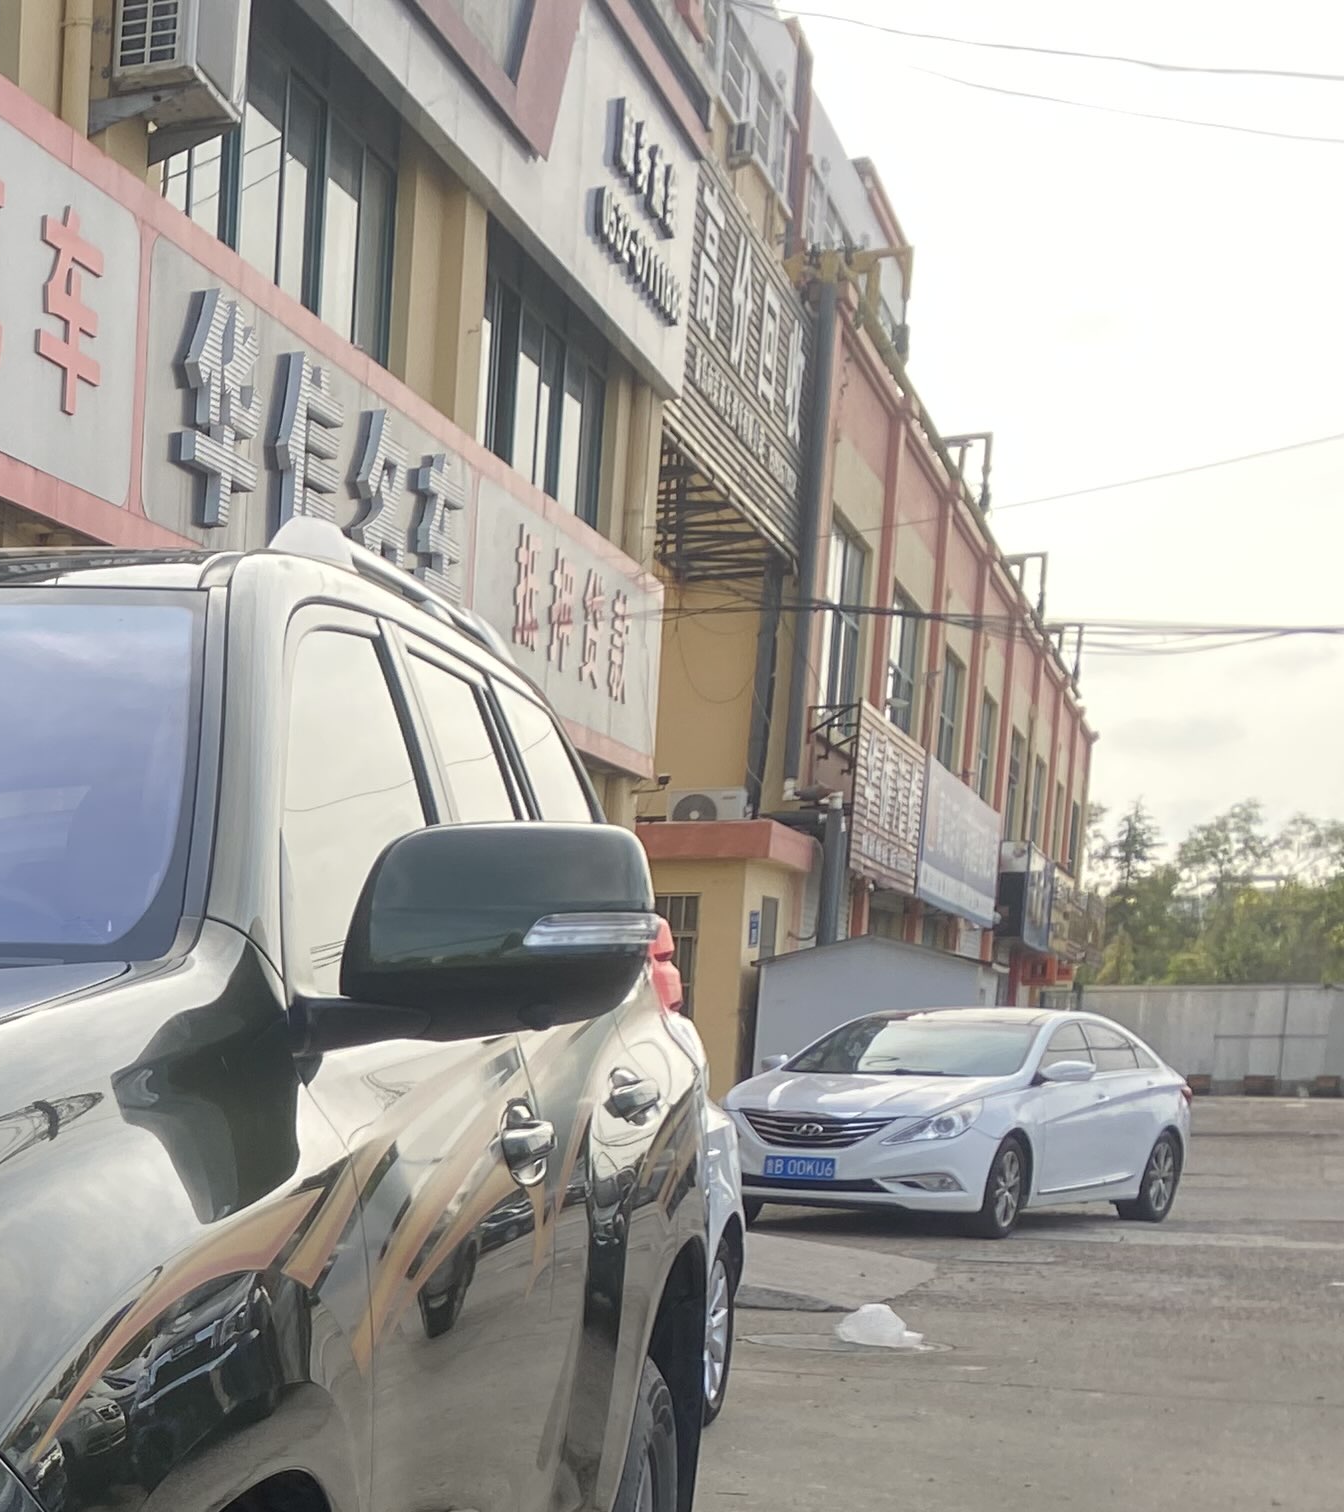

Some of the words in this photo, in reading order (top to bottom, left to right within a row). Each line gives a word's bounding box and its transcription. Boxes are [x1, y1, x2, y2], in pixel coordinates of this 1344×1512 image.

[694, 184, 805, 448] 高价回收
[513, 523, 633, 704] 抵押贷款
